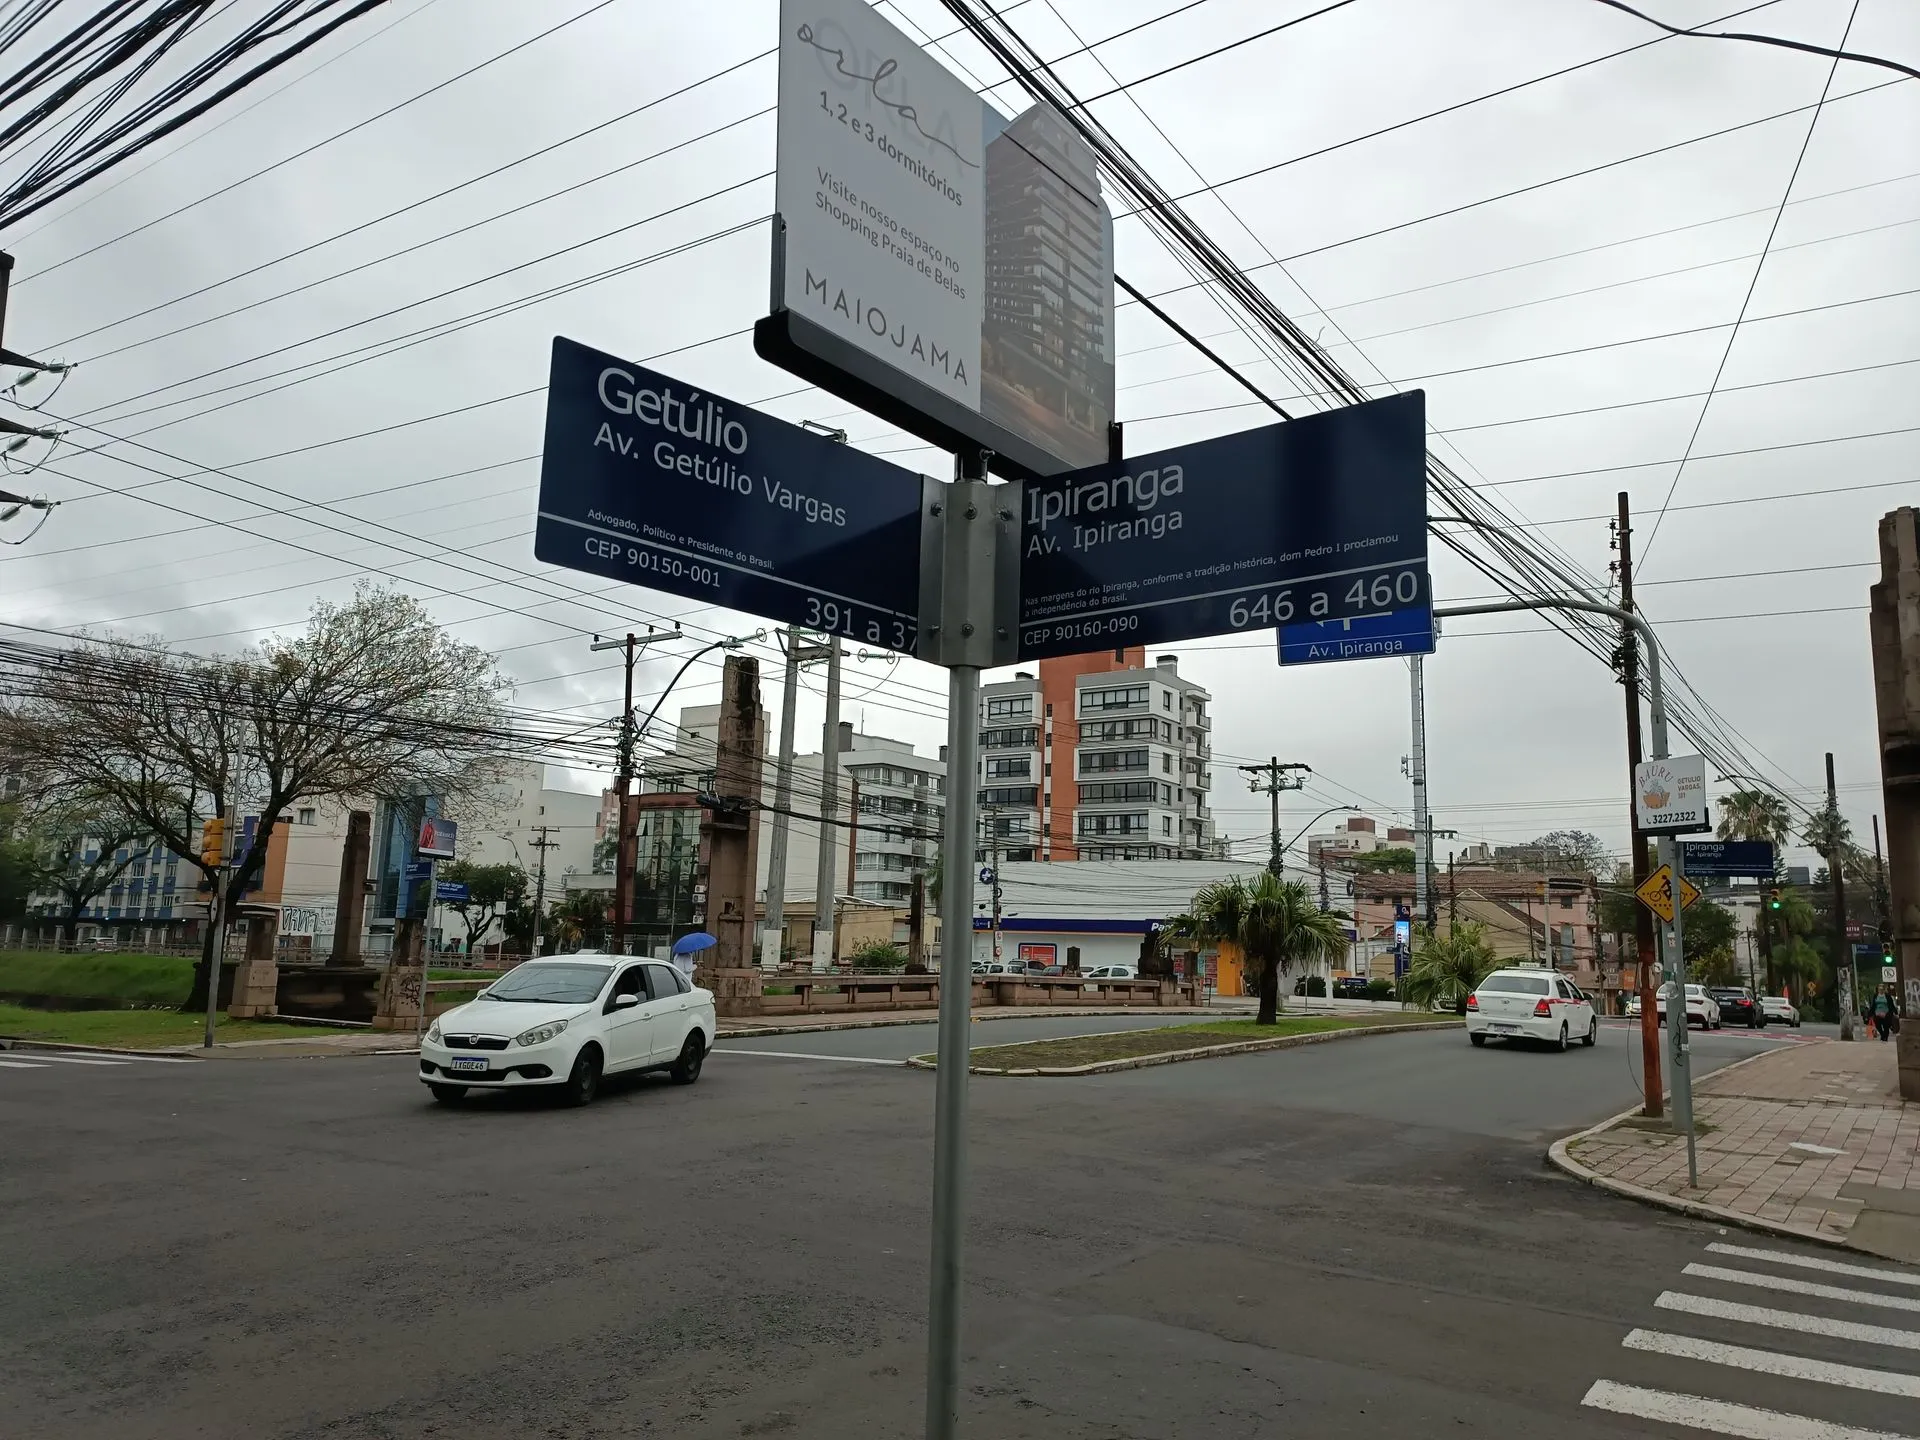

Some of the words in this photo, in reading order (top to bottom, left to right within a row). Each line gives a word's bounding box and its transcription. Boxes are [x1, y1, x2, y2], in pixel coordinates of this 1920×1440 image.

[838, 103, 848, 125] 2
[852, 118, 861, 133] e
[865, 124, 875, 143] 3
[877, 135, 962, 206] dormitórios
[815, 191, 878, 247] Shopping
[882, 234, 914, 267] Praia
[917, 258, 932, 279] de
[935, 267, 966, 300] Belas
[817, 166, 857, 206] Visite
[861, 200, 898, 232] nosso
[900, 227, 942, 262] espaço
[945, 255, 960, 273] no
[805, 268, 967, 386] MAIOJAMA
[597, 367, 748, 454] Getúlio
[593, 422, 639, 459] Av.
[653, 442, 752, 495] Getúlio
[763, 476, 846, 526] Vargas
[1027, 464, 1184, 531] Ipiranga
[585, 537, 621, 560] CEP
[627, 548, 721, 588] 90150-001
[588, 508, 639, 533] Advogado,
[643, 524, 676, 542] Político
[679, 536, 685, 544] e
[687, 537, 734, 559] Presidente
[736, 551, 747, 562] do
[749, 556, 775, 570] Brasil.
[1027, 534, 1061, 558] Av.
[1073, 510, 1183, 552] Ipiranga
[1040, 591, 1074, 603] margens
[1076, 588, 1087, 597] do
[1089, 586, 1100, 595] rio
[1102, 580, 1140, 594] Ipiranga,
[1142, 572, 1184, 586] conforme
[1186, 570, 1192, 579] a
[1194, 562, 1231, 577] tradição
[1233, 554, 1277, 570] histórica,
[1280, 549, 1301, 562] dom
[1304, 544, 1333, 557] Pedro
[1343, 533, 1399, 553] proclamou
[805, 597, 854, 636] 391
[866, 620, 881, 643] a
[1032, 600, 1087, 616] independência
[1089, 598, 1100, 606] do
[1102, 593, 1128, 604] Brasil.
[1229, 590, 1294, 627] 646
[1309, 591, 1329, 616] a
[1344, 570, 1418, 609] 460
[1024, 629, 1051, 645] CEP
[1055, 615, 1138, 641] 90160-090
[1308, 644, 1334, 657] Av.
[1340, 640, 1402, 657] Ipiranga
[1638, 765, 1674, 788] BAURU
[1652, 811, 1696, 824] 3227.2322
[1686, 842, 1724, 853] Ipiranga
